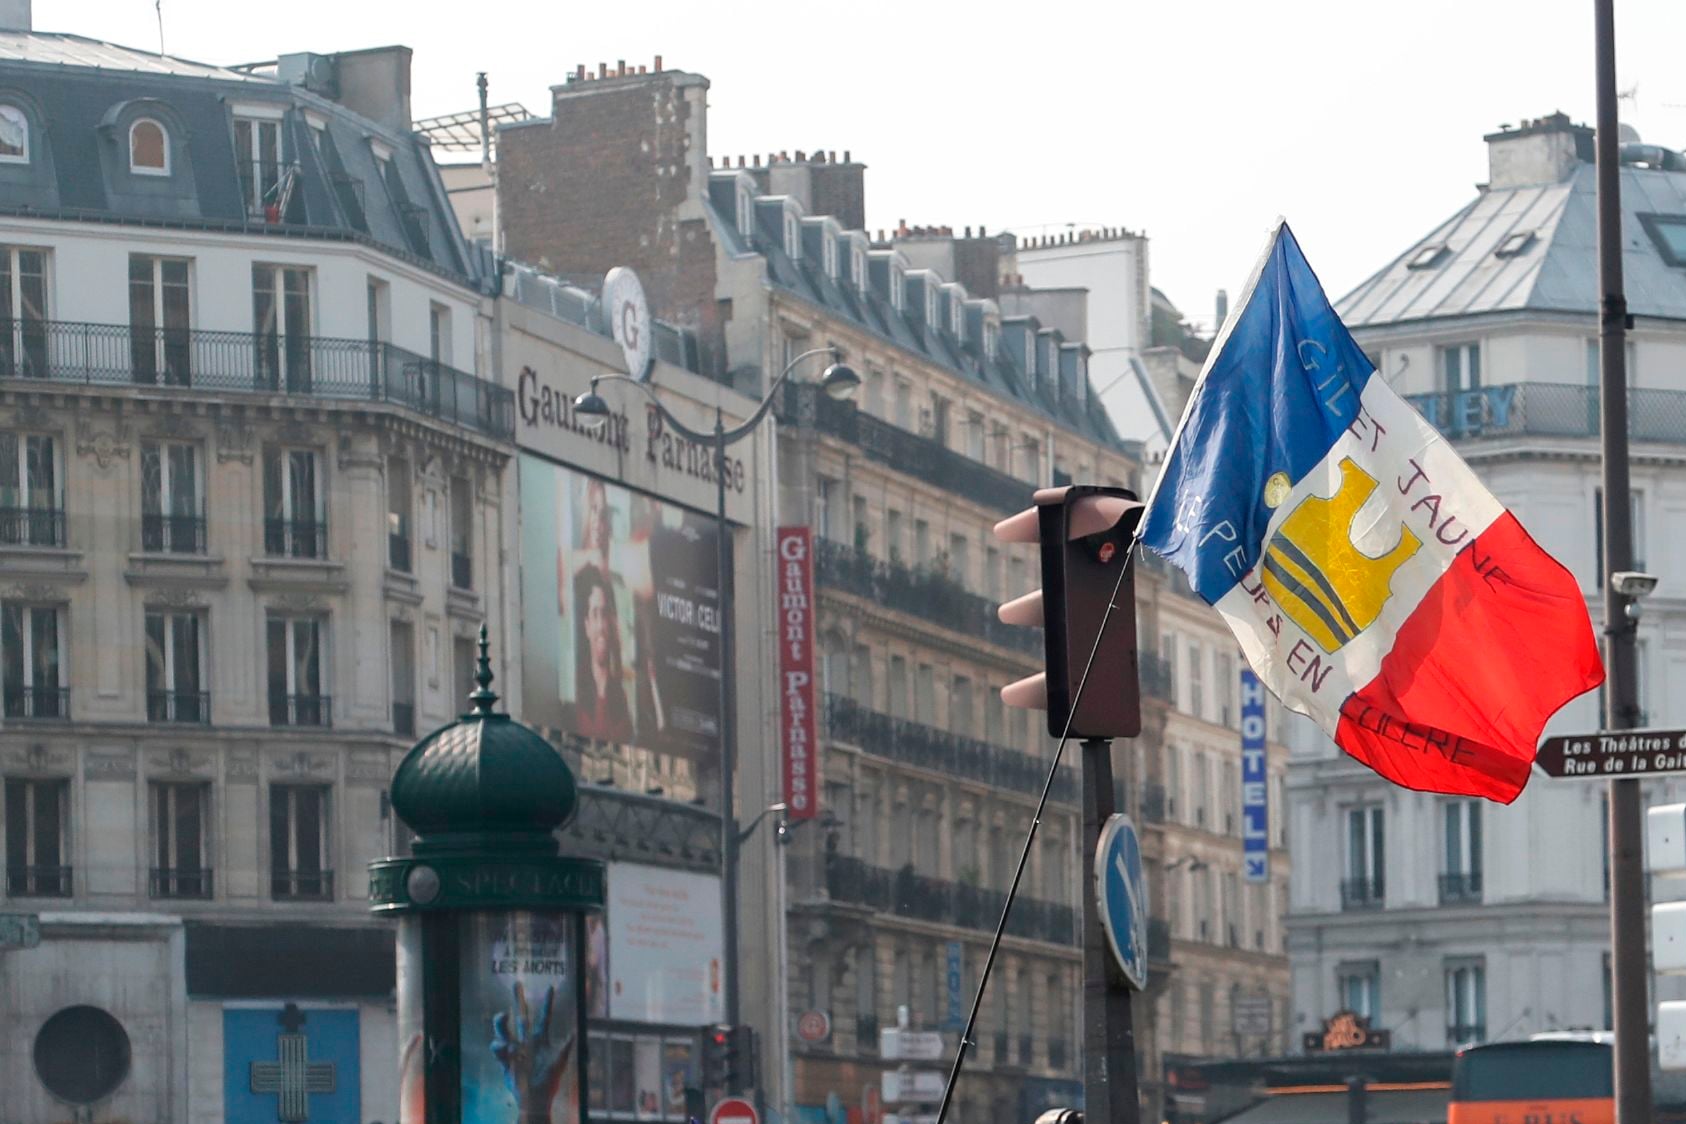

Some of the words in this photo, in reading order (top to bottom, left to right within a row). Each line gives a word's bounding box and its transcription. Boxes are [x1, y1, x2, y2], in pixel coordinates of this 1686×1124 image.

[1397, 458, 1512, 594] JAUNE
[656, 593, 693, 625] VICTOR
[780, 536, 807, 661] Gaumont
[1286, 638, 1334, 693] EN
[786, 671, 809, 811] Parnasse
[1243, 682, 1266, 840] HOTEL
[1563, 739, 1592, 756] Les
[1599, 735, 1671, 754] Théâtres
[1564, 759, 1596, 775] Rue
[1604, 757, 1624, 773] de
[1632, 755, 1647, 771] la
[491, 959, 519, 982] LES
[525, 960, 567, 983] MORTS
